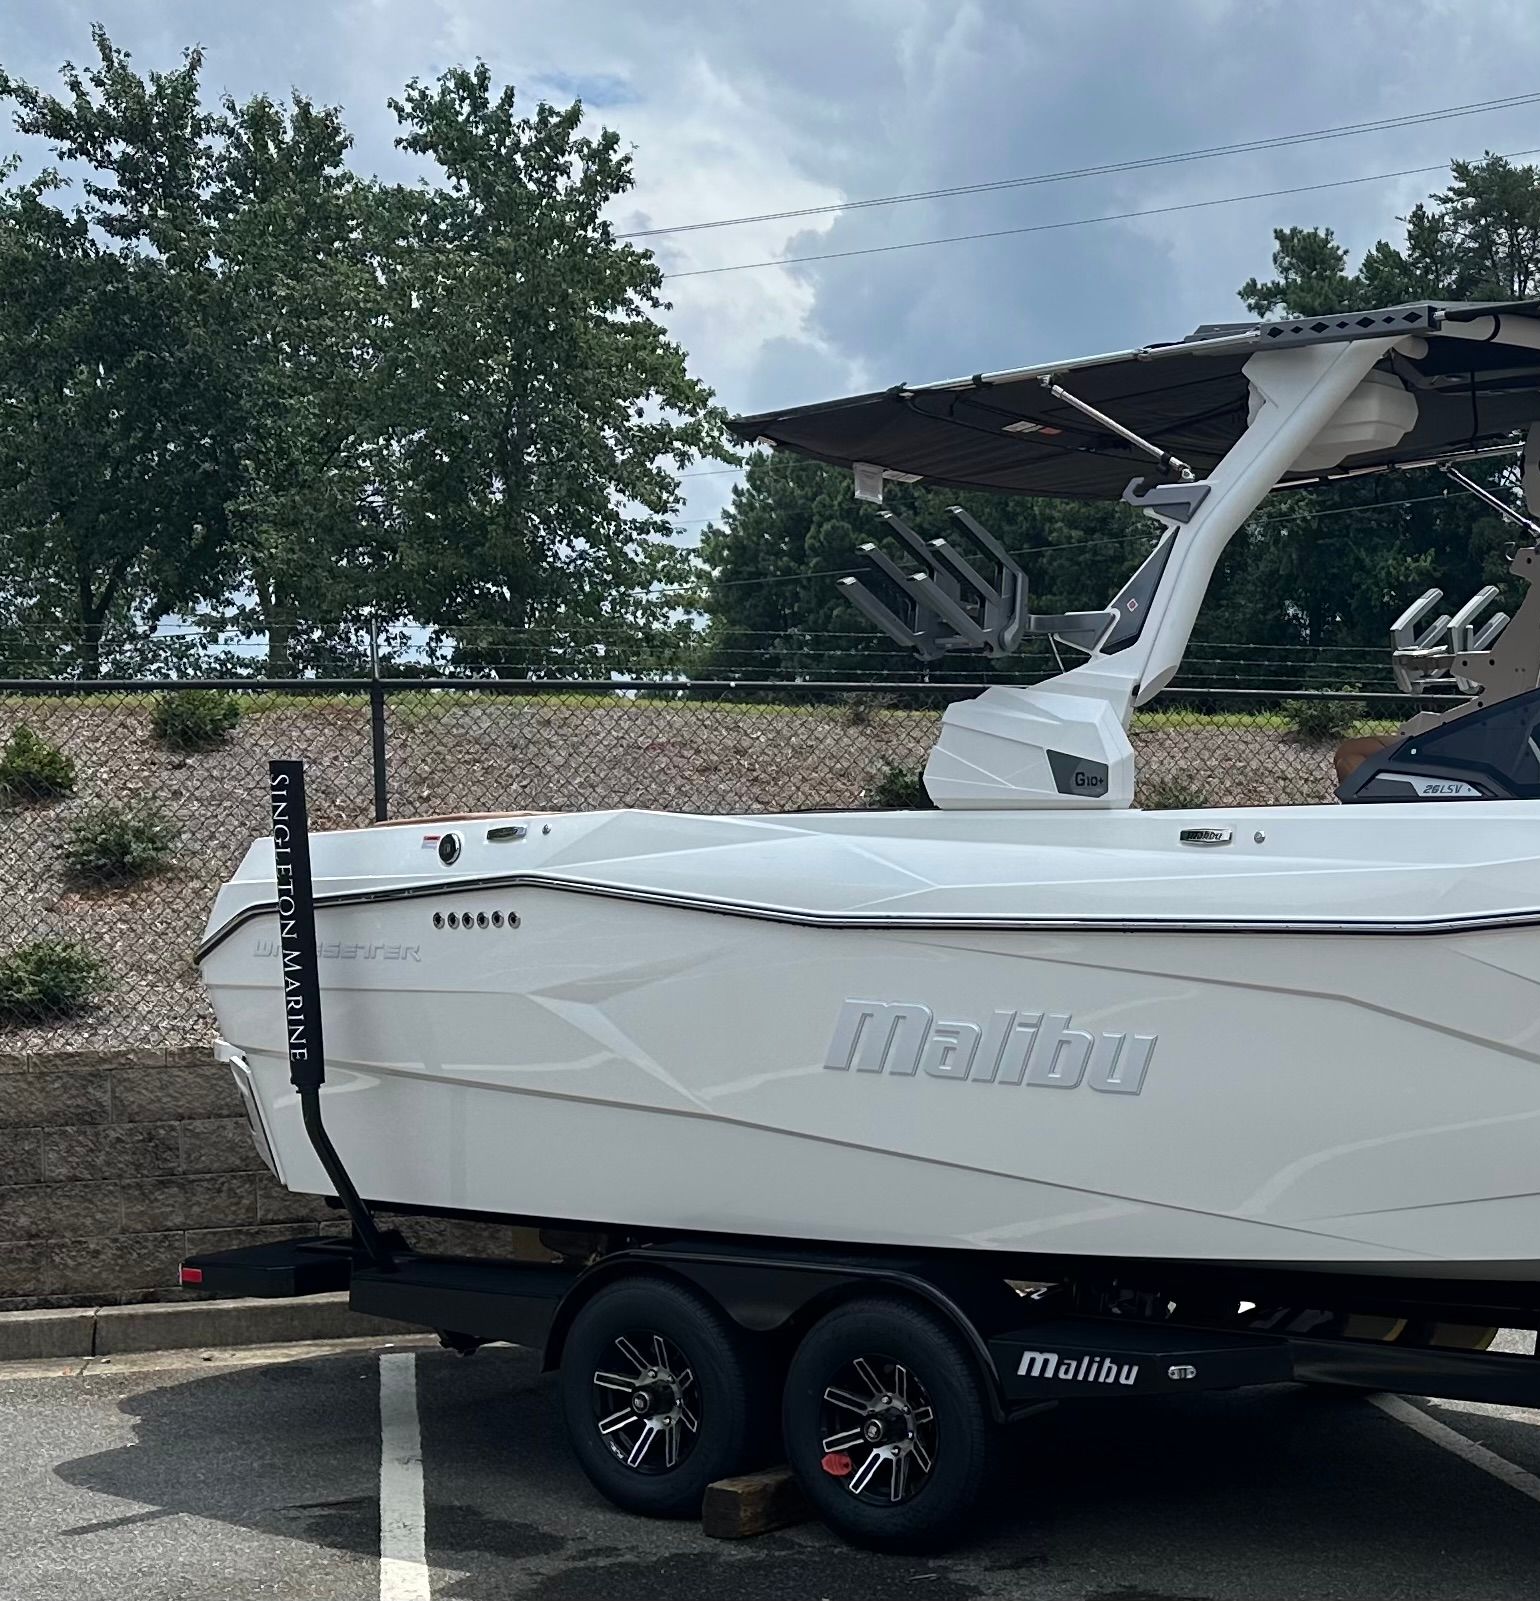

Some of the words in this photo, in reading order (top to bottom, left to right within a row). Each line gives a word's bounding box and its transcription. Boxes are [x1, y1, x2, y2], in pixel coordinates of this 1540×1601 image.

[1422, 784, 1463, 794] 26LSV
[270, 773, 298, 939] SINGLETON
[282, 949, 309, 1062] MARINE
[823, 997, 1159, 1096] Malibu
[1016, 1350, 1139, 1386] Malibu
